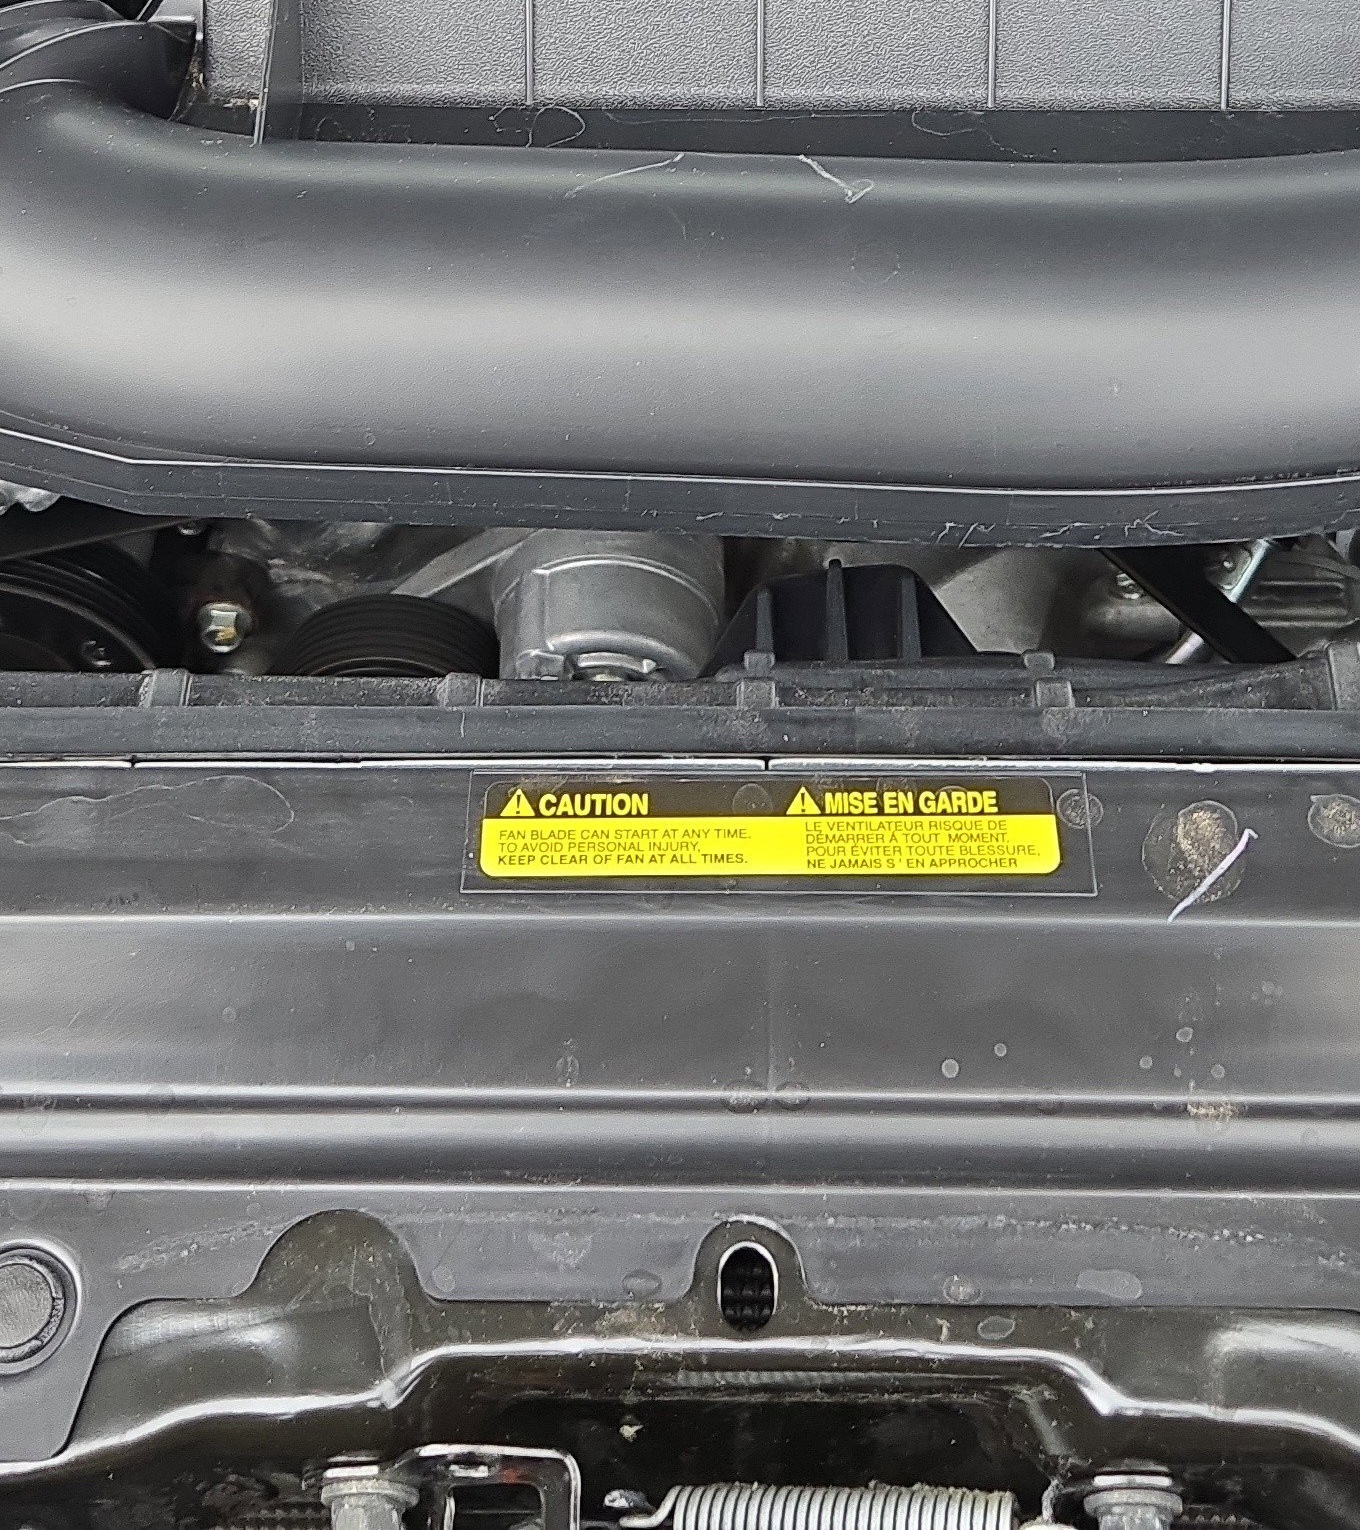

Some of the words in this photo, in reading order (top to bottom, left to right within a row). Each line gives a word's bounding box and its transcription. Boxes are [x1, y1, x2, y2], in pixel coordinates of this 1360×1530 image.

[539, 793, 649, 816] CAUTION
[824, 792, 878, 814] MISE
[883, 792, 914, 814] EN
[919, 791, 999, 814] GARDE
[805, 822, 822, 832] LE
[827, 821, 924, 831] VENTILATEUR
[929, 820, 983, 831] RISQUE
[987, 820, 1007, 830] DE
[499, 830, 526, 841] FAN
[531, 830, 576, 840] BLADE
[580, 829, 610, 840] CAN
[614, 829, 657, 840] START
[662, 829, 679, 839] AT
[682, 829, 711, 839] ANY
[806, 830, 885, 844] DÉMARRER
[903, 833, 939, 843] TOUT
[499, 842, 517, 852] TO
[521, 842, 564, 852] AVOID
[568, 841, 645, 852] PERSONAL
[806, 846, 846, 856] POUR
[851, 843, 902, 856] ÉVITER
[907, 846, 954, 856] TOUTE
[498, 855, 536, 866] KEEP
[540, 854, 588, 865] CLEAR
[593, 854, 612, 864] OF
[617, 854, 645, 864] FAN
[649, 854, 666, 864] AT
[670, 853, 697, 864] ALL
[807, 859, 826, 869] NE
[830, 858, 882, 869] JAMAIS
[930, 858, 1018, 869] APPROCHER
